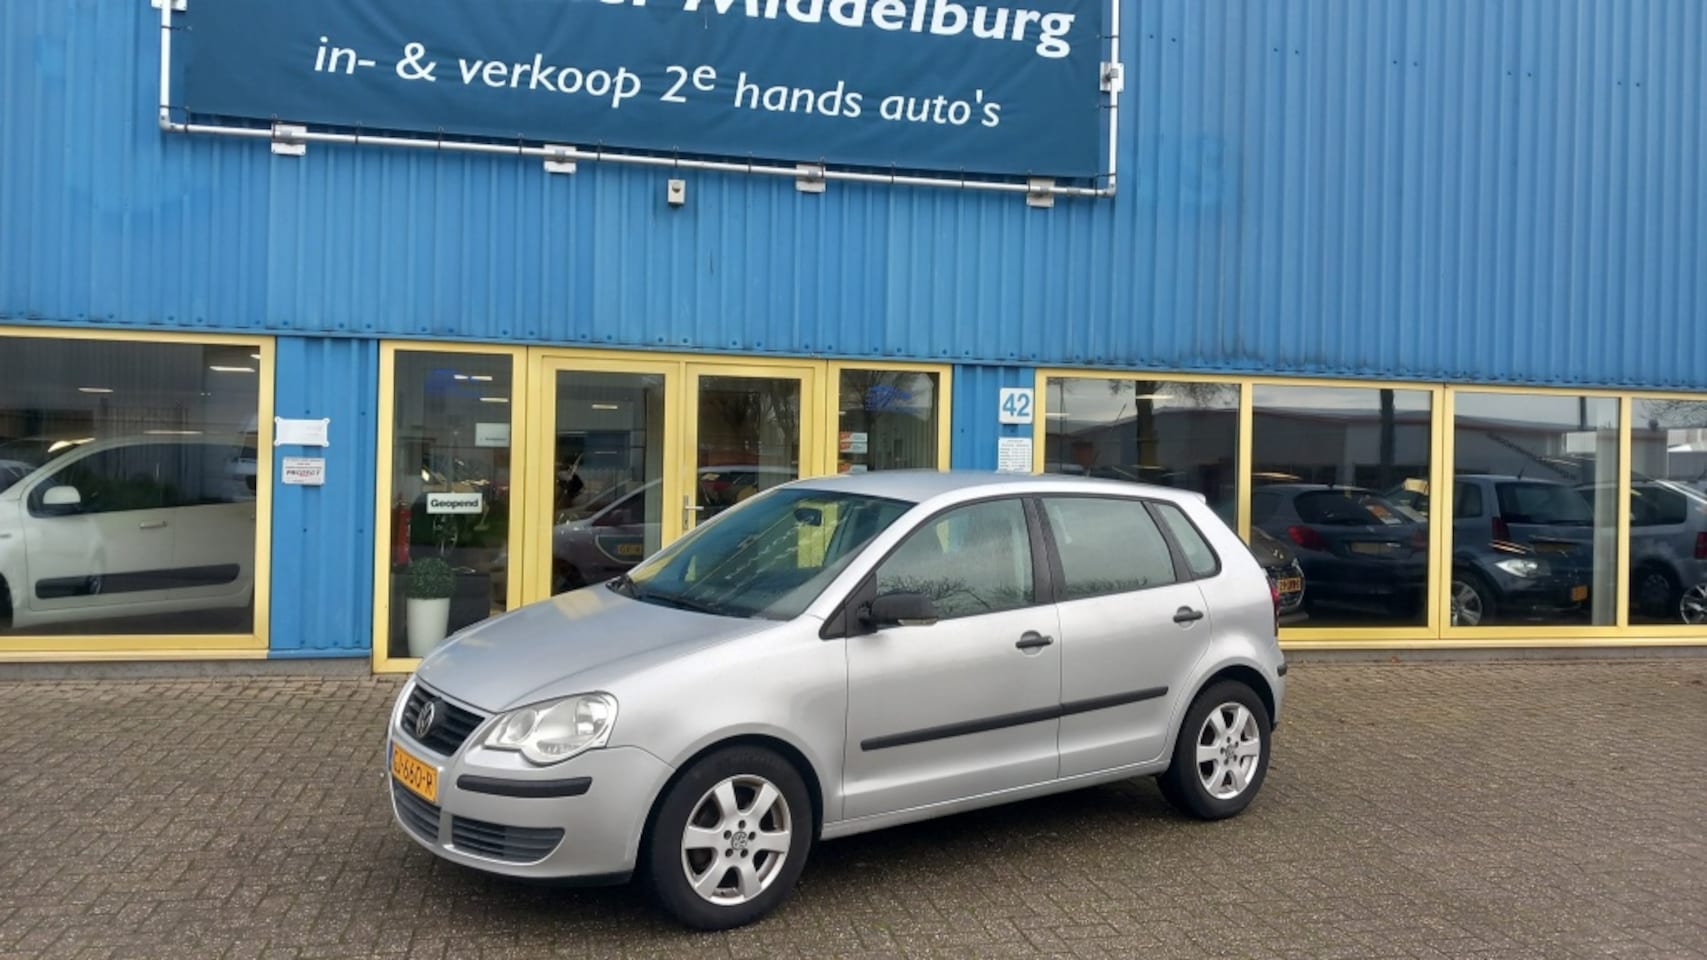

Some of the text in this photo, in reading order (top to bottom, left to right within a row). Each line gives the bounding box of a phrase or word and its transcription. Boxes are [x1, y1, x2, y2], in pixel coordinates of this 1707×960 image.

[314, 36, 377, 75] in-
[396, 42, 437, 82] &
[459, 54, 641, 108] verkoop
[734, 71, 864, 118] hands
[879, 89, 1001, 128] auto's
[1002, 392, 1031, 417] 42
[430, 498, 479, 509] Geopend
